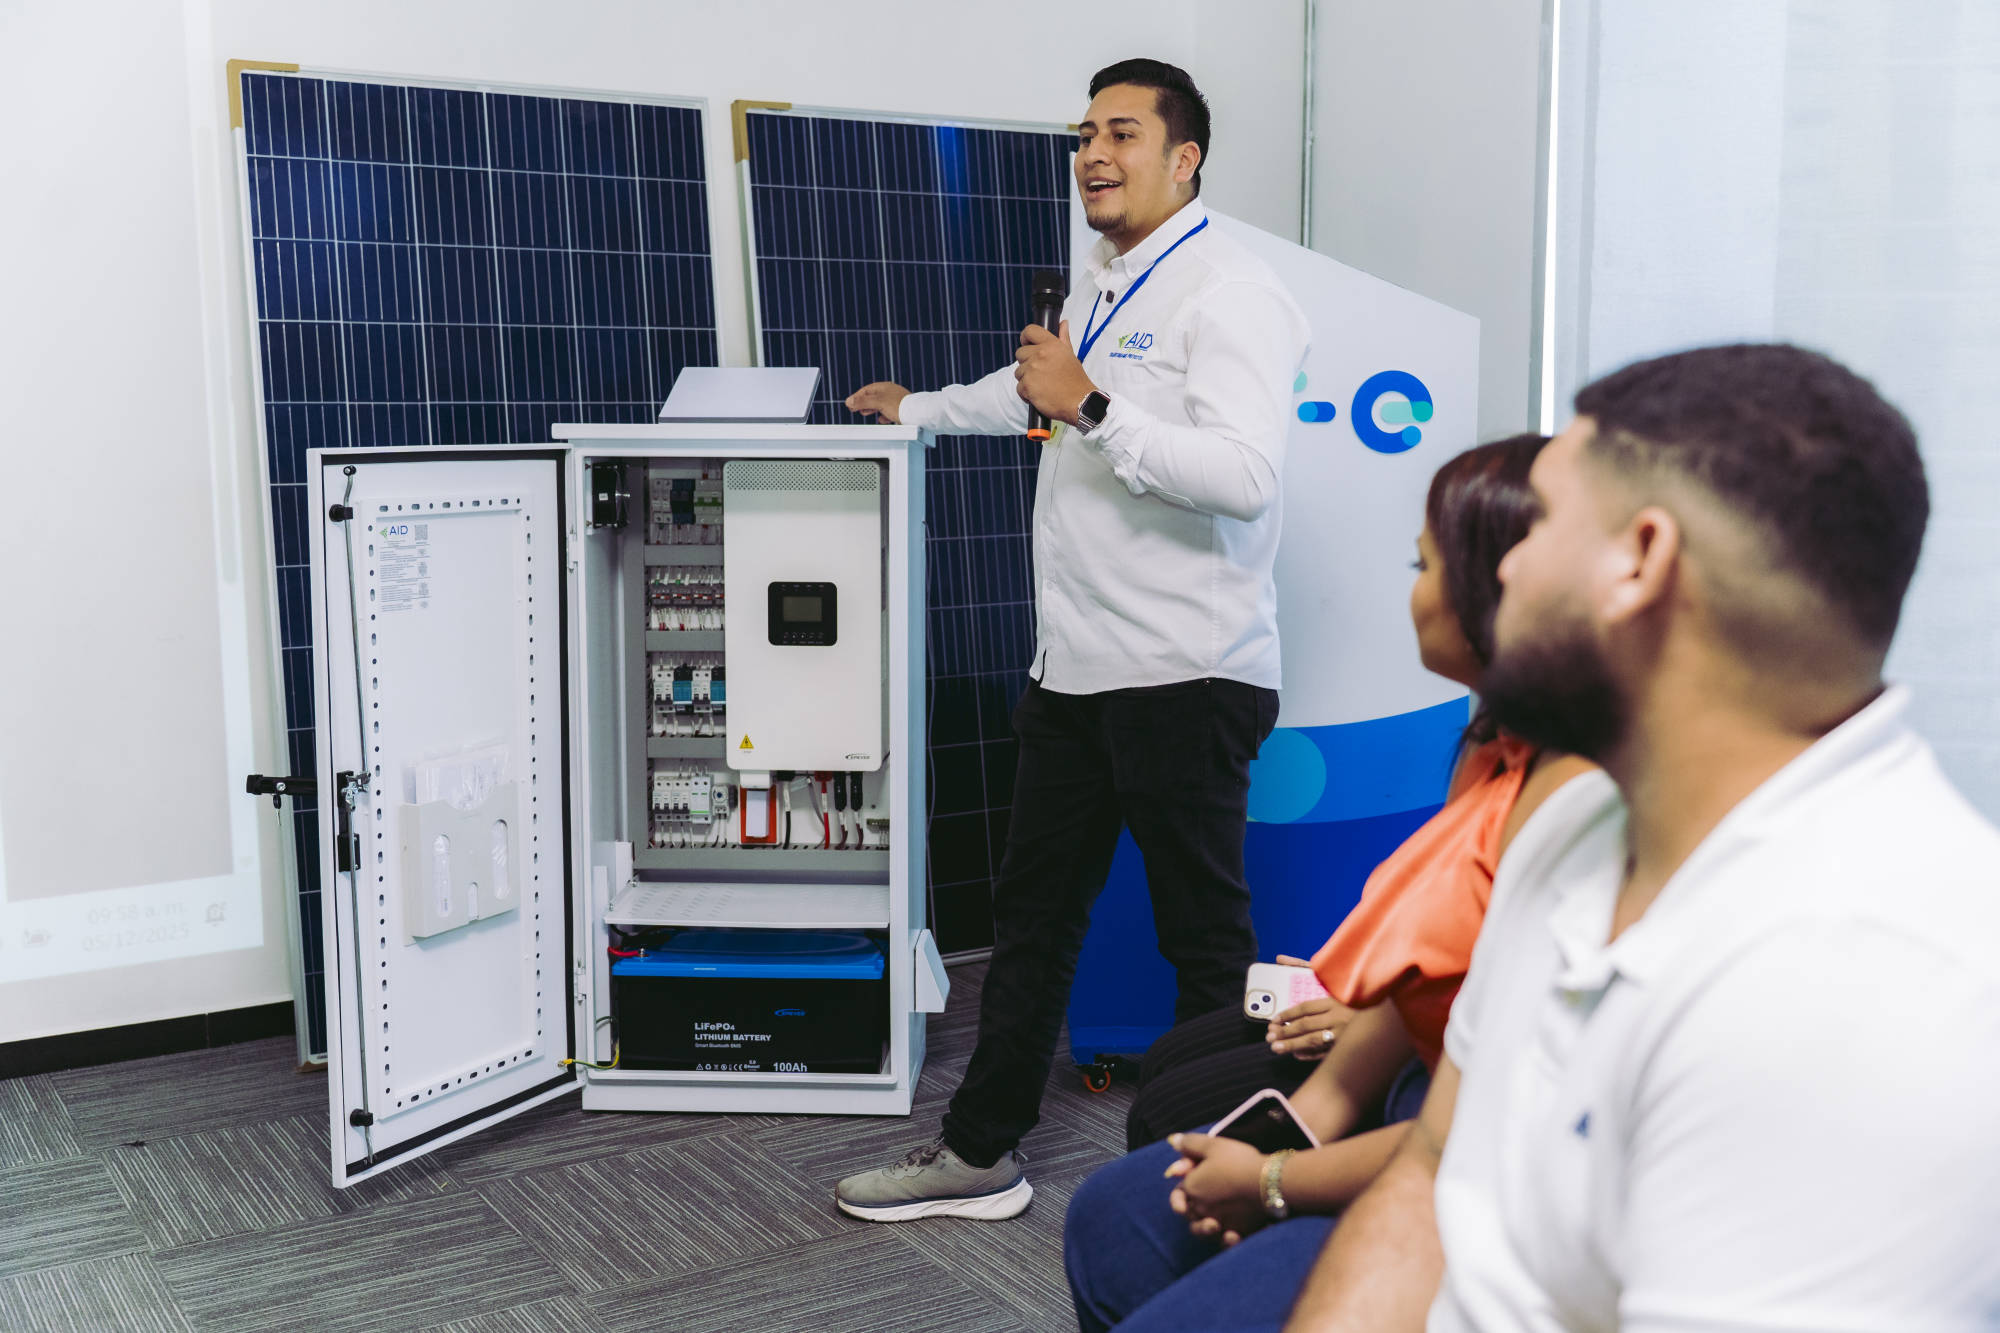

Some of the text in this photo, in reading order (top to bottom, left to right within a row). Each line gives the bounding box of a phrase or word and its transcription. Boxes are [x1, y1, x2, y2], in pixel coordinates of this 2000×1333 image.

[1124, 332, 1153, 350] AID
[389, 525, 408, 536] AID
[81, 921, 191, 952] 05/12/2025
[694, 1033, 772, 1042] LITHIUM BATTERY
[773, 1062, 808, 1073] 100Ah
